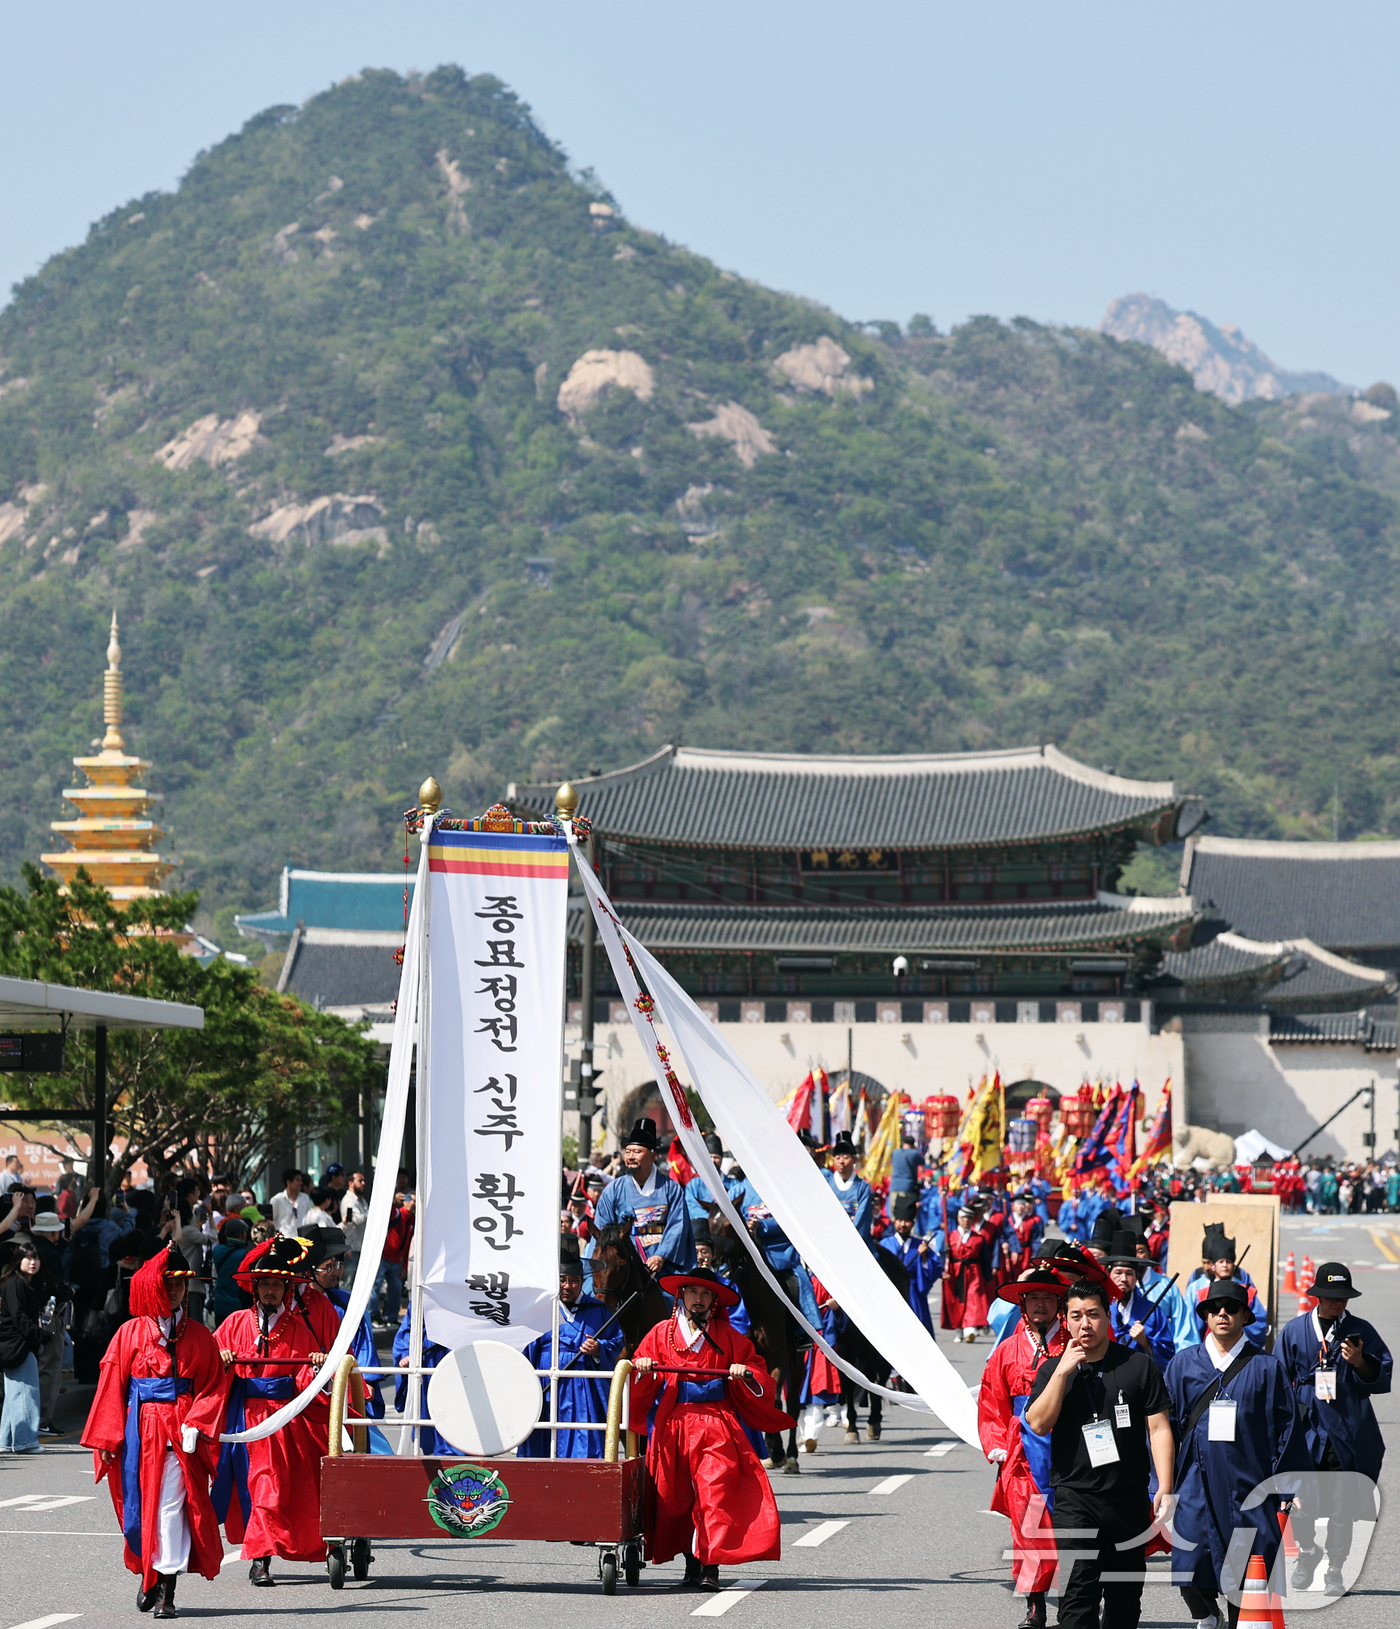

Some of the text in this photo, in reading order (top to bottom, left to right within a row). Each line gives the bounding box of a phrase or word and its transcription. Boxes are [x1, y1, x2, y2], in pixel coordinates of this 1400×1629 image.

[465, 897, 524, 1326] 종묘정전 신주 환안 행렬
